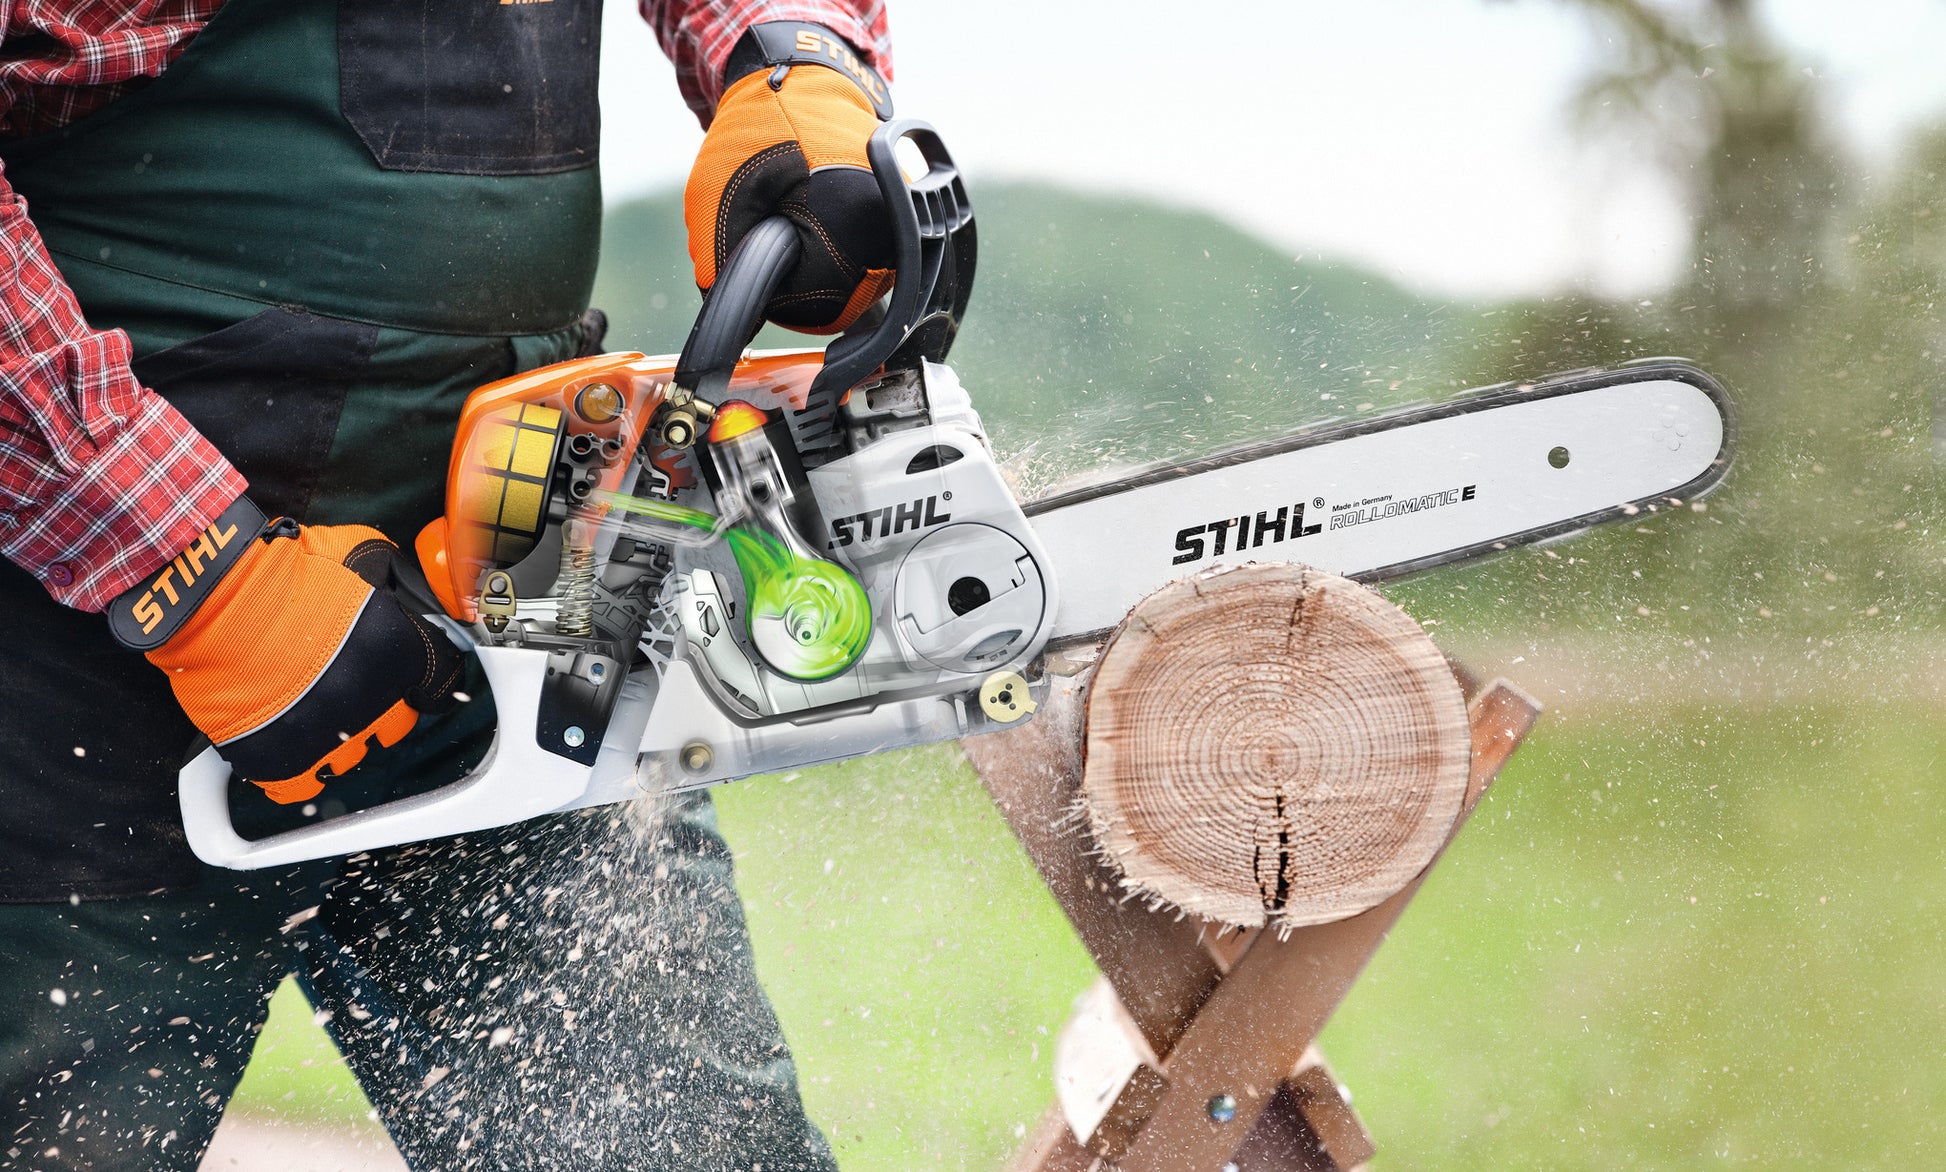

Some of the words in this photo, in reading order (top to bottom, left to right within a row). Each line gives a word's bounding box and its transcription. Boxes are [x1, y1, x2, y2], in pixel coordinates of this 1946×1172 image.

[795, 29, 884, 106] STIHL
[827, 495, 952, 551] STIHL
[1329, 488, 1459, 531] ROLLOMATIC
[1461, 484, 1477, 502] E
[1332, 502, 1352, 513] Made
[1353, 500, 1360, 508] in
[1361, 494, 1393, 506] Germany
[1172, 502, 1323, 566] STIHL
[131, 523, 239, 636] STIHL
